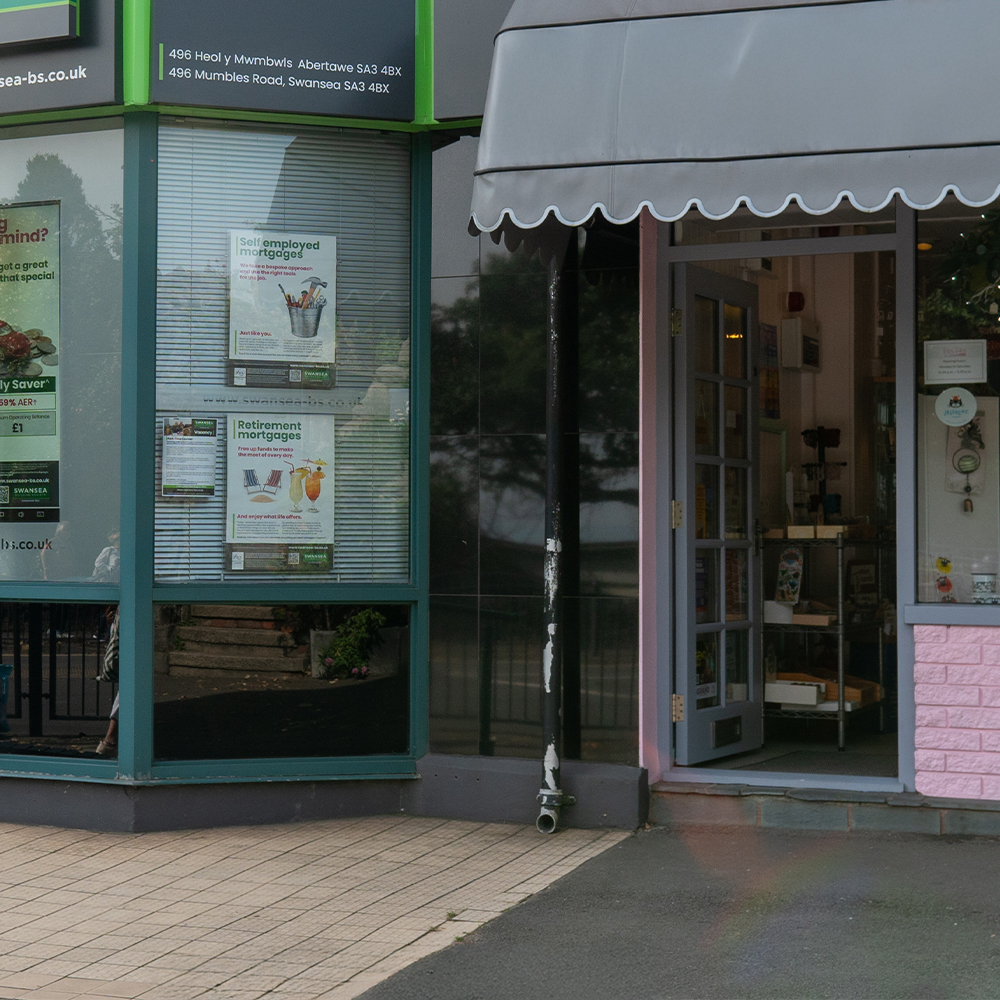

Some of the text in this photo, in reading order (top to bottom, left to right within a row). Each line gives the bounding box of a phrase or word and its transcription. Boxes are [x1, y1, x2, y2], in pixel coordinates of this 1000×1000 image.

[169, 48, 402, 77] 496 Heol y Mwmbwls Abertawe SA3 4BX
[169, 67, 390, 94] 496 Mumbles Road, Swansea SA3 4BX
[0, 228, 49, 245] mind?
[240, 237, 320, 251] Self employed
[240, 247, 303, 260] mortgages
[22, 260, 48, 272] great
[0, 273, 19, 283] that
[21, 271, 55, 283] special
[12, 422, 23, 433] £1
[238, 420, 302, 431] Retirement
[238, 430, 302, 442] mortgages
